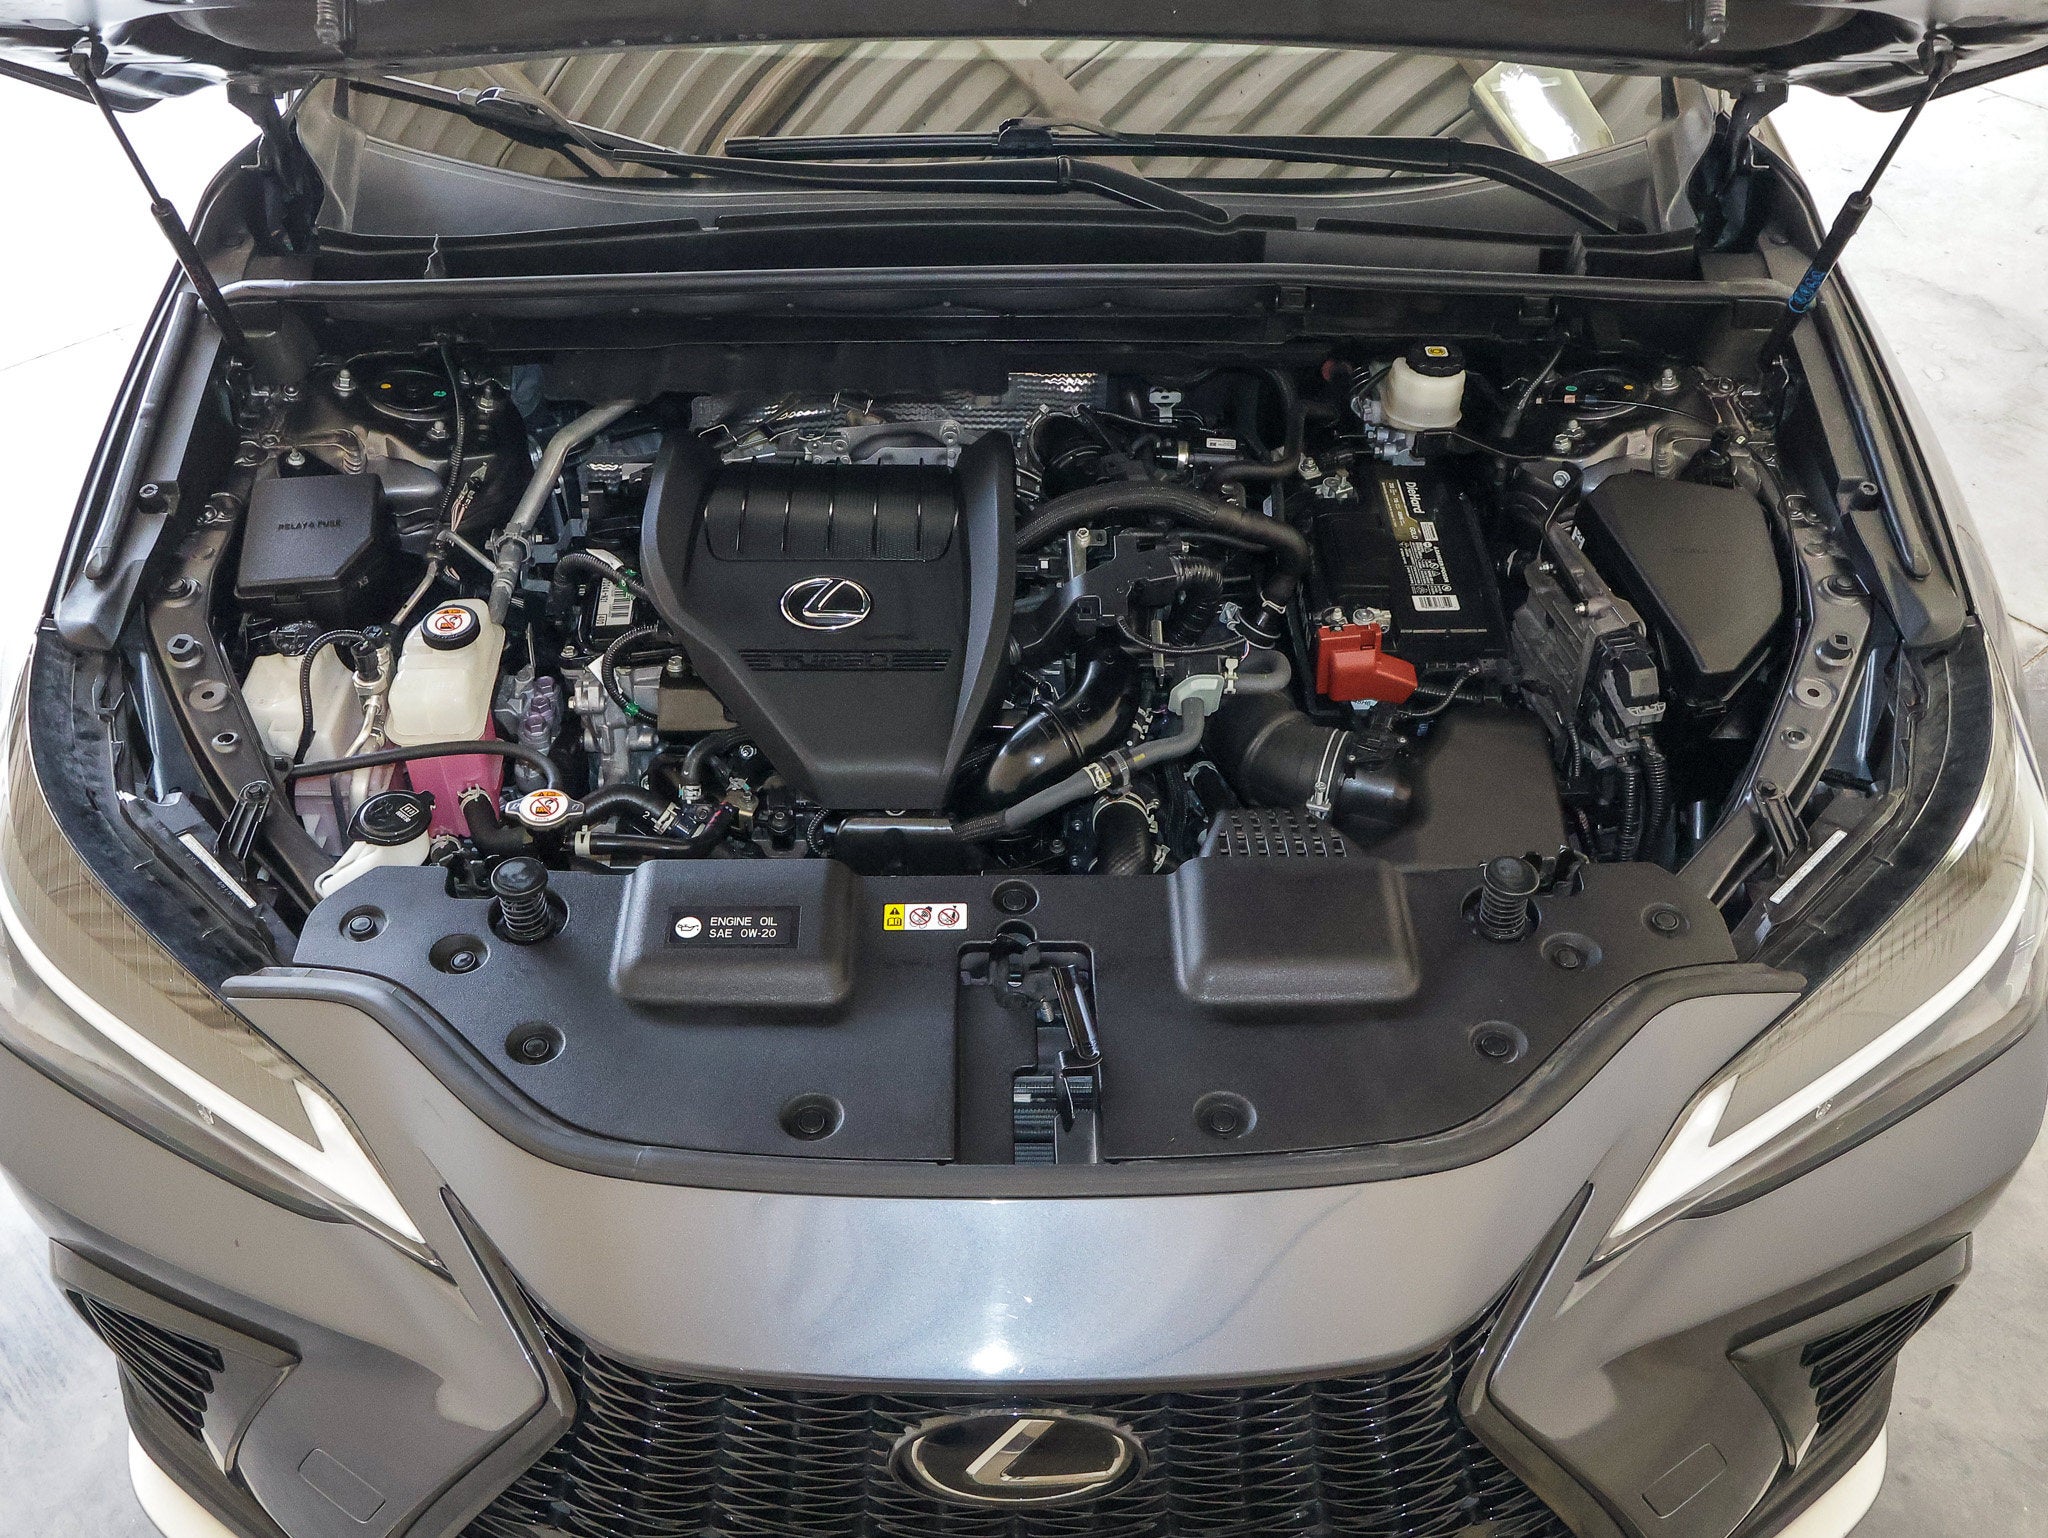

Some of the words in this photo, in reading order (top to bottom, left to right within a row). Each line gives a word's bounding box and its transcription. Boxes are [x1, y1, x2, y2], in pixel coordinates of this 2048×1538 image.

[1405, 481, 1425, 514] DieHard
[710, 917, 752, 926] ENGINE
[760, 917, 777, 926] OIL
[709, 929, 732, 938] SAE
[740, 929, 776, 938] 0W-20
